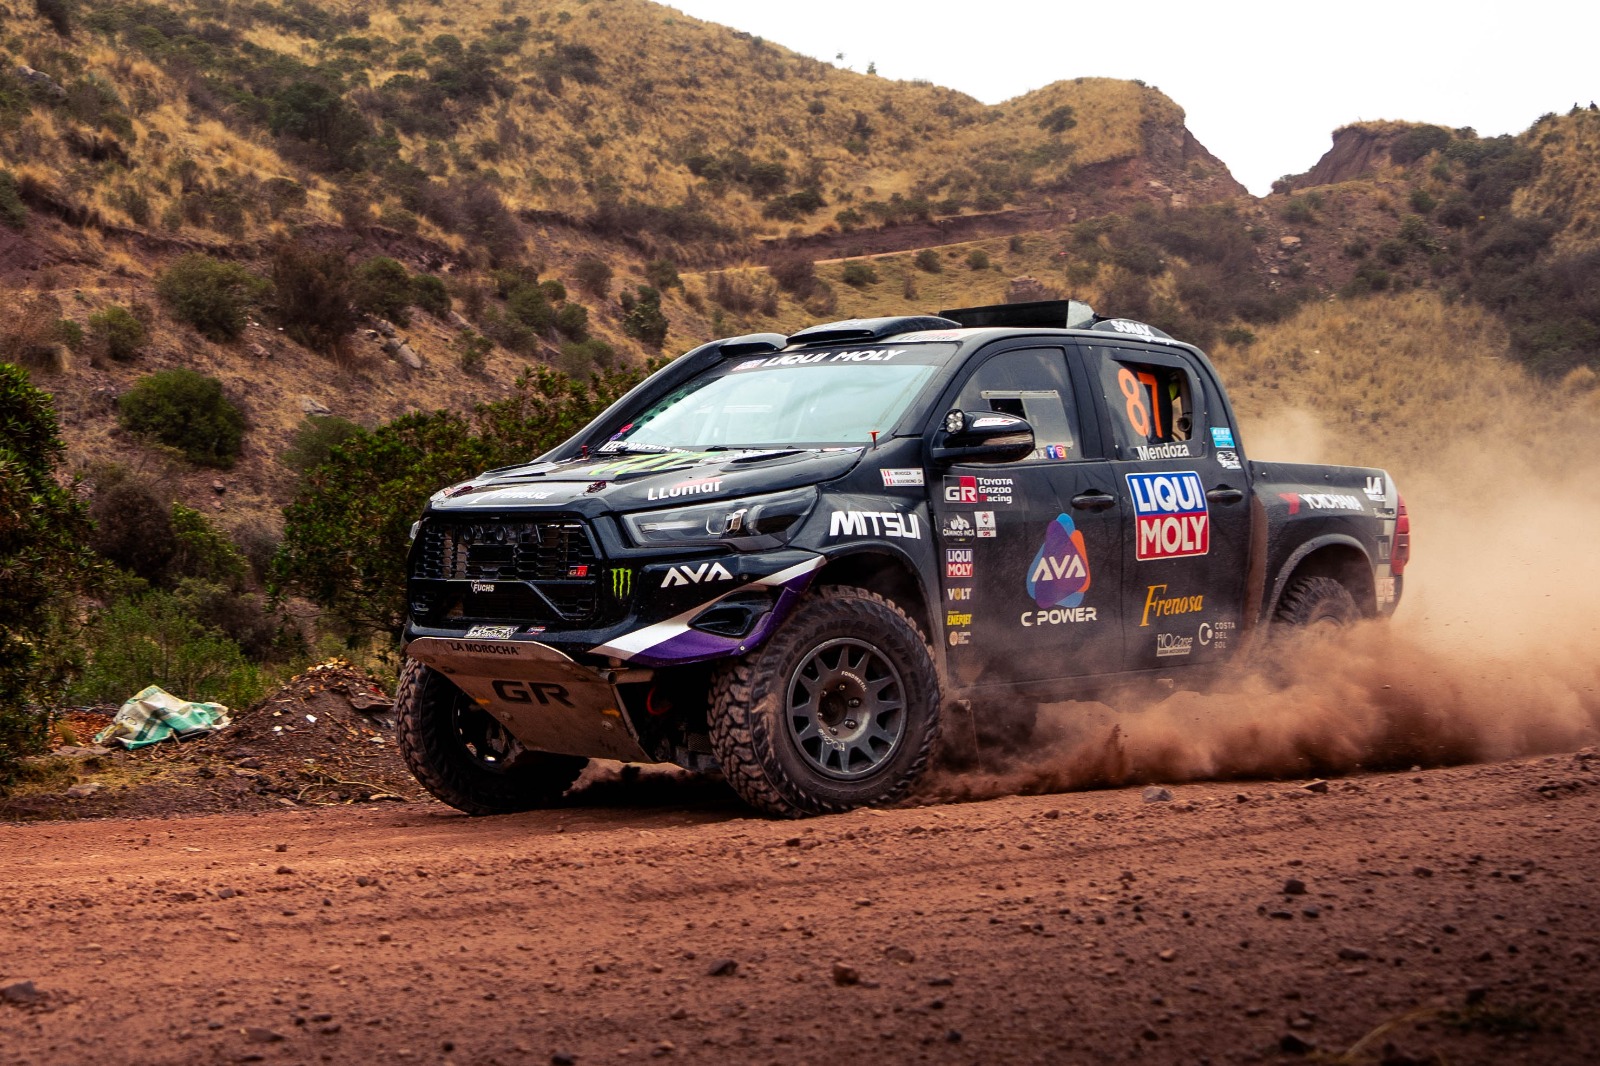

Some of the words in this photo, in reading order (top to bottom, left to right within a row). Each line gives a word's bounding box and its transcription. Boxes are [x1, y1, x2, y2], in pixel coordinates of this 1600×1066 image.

[762, 353, 831, 367] LIQUI
[830, 350, 907, 362] MOLY
[1118, 368, 1163, 438] 87
[1136, 442, 1190, 461] Mendoza
[647, 481, 723, 500] LLumar
[976, 477, 1014, 486] TOYOTA
[978, 486, 1012, 494] GAZOO
[945, 486, 977, 502] GR
[1131, 476, 1204, 513] LIQUI
[1298, 493, 1365, 512] YOKOHAMA
[829, 511, 921, 540] MITSUI
[1140, 515, 1207, 555] MOLY
[947, 550, 972, 563] LIQUI
[568, 569, 587, 577] GR
[661, 562, 733, 588] AVA
[947, 563, 972, 576] MOLY
[1031, 554, 1087, 582] AVA
[473, 584, 495, 592] FUCHS
[947, 587, 972, 600] VOLT
[1139, 584, 1204, 627] Frenosa
[1021, 611, 1033, 627] C
[1037, 607, 1098, 626] POWER
[1214, 621, 1236, 630] COSTA
[1214, 631, 1227, 640] DEL
[1214, 641, 1227, 649] SOL
[841, 670, 868, 692] FONDMETAL
[491, 680, 576, 709] GR
